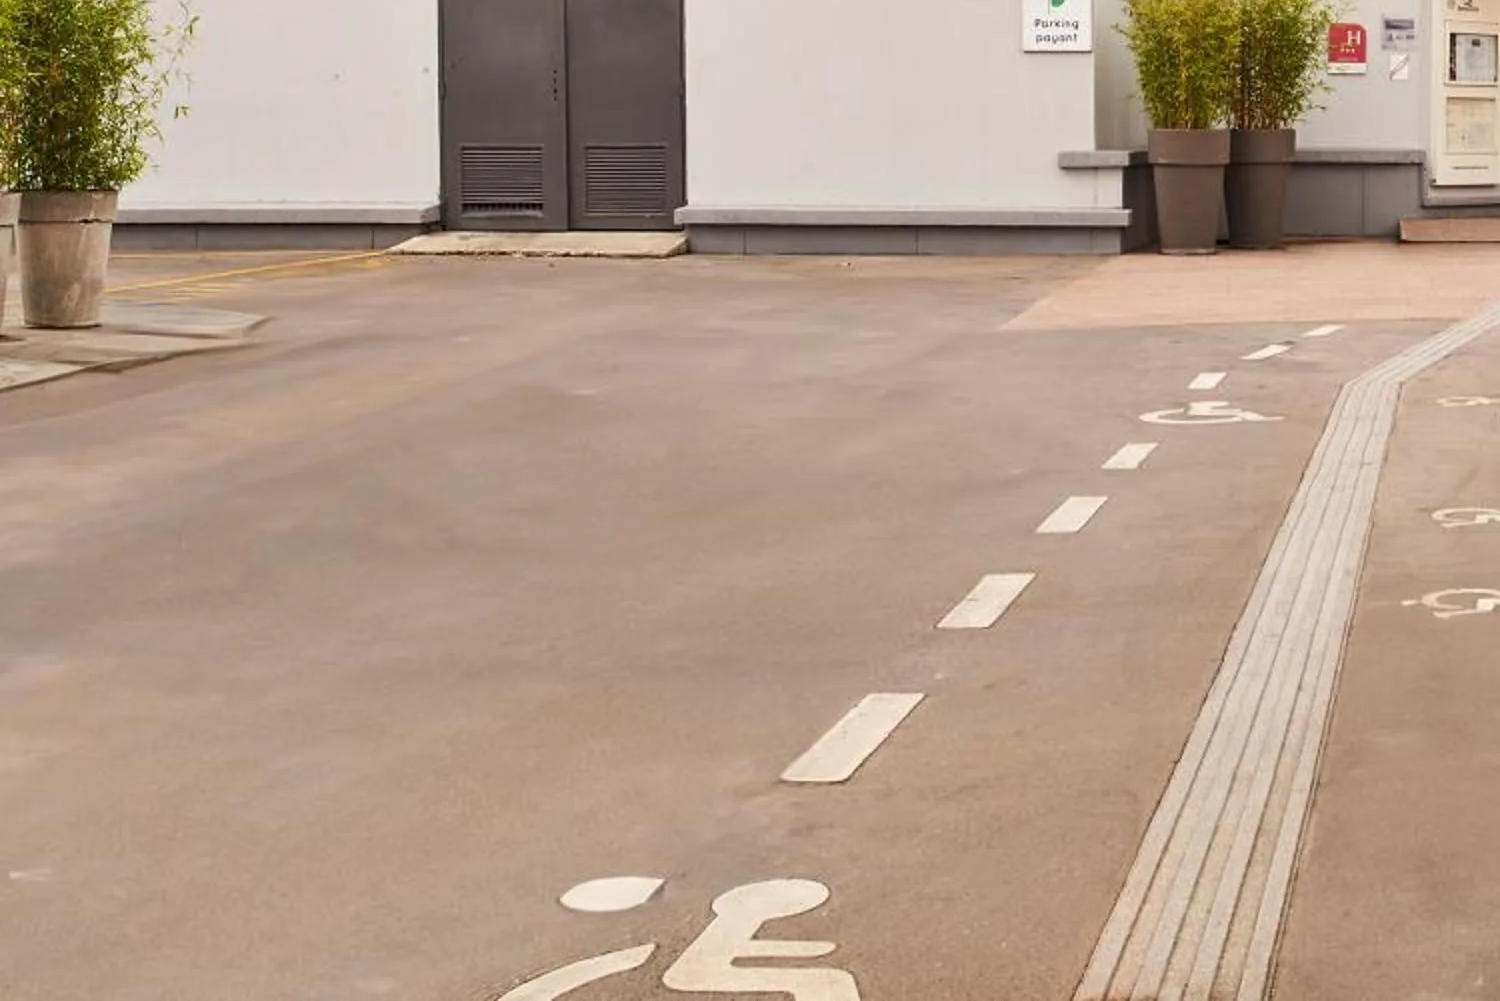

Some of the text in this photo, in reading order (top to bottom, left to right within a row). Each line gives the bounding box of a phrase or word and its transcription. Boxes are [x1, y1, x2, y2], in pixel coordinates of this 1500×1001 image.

[1033, 18, 1080, 30] Parking
[1035, 33, 1078, 44] payant
[1347, 30, 1361, 46] H
